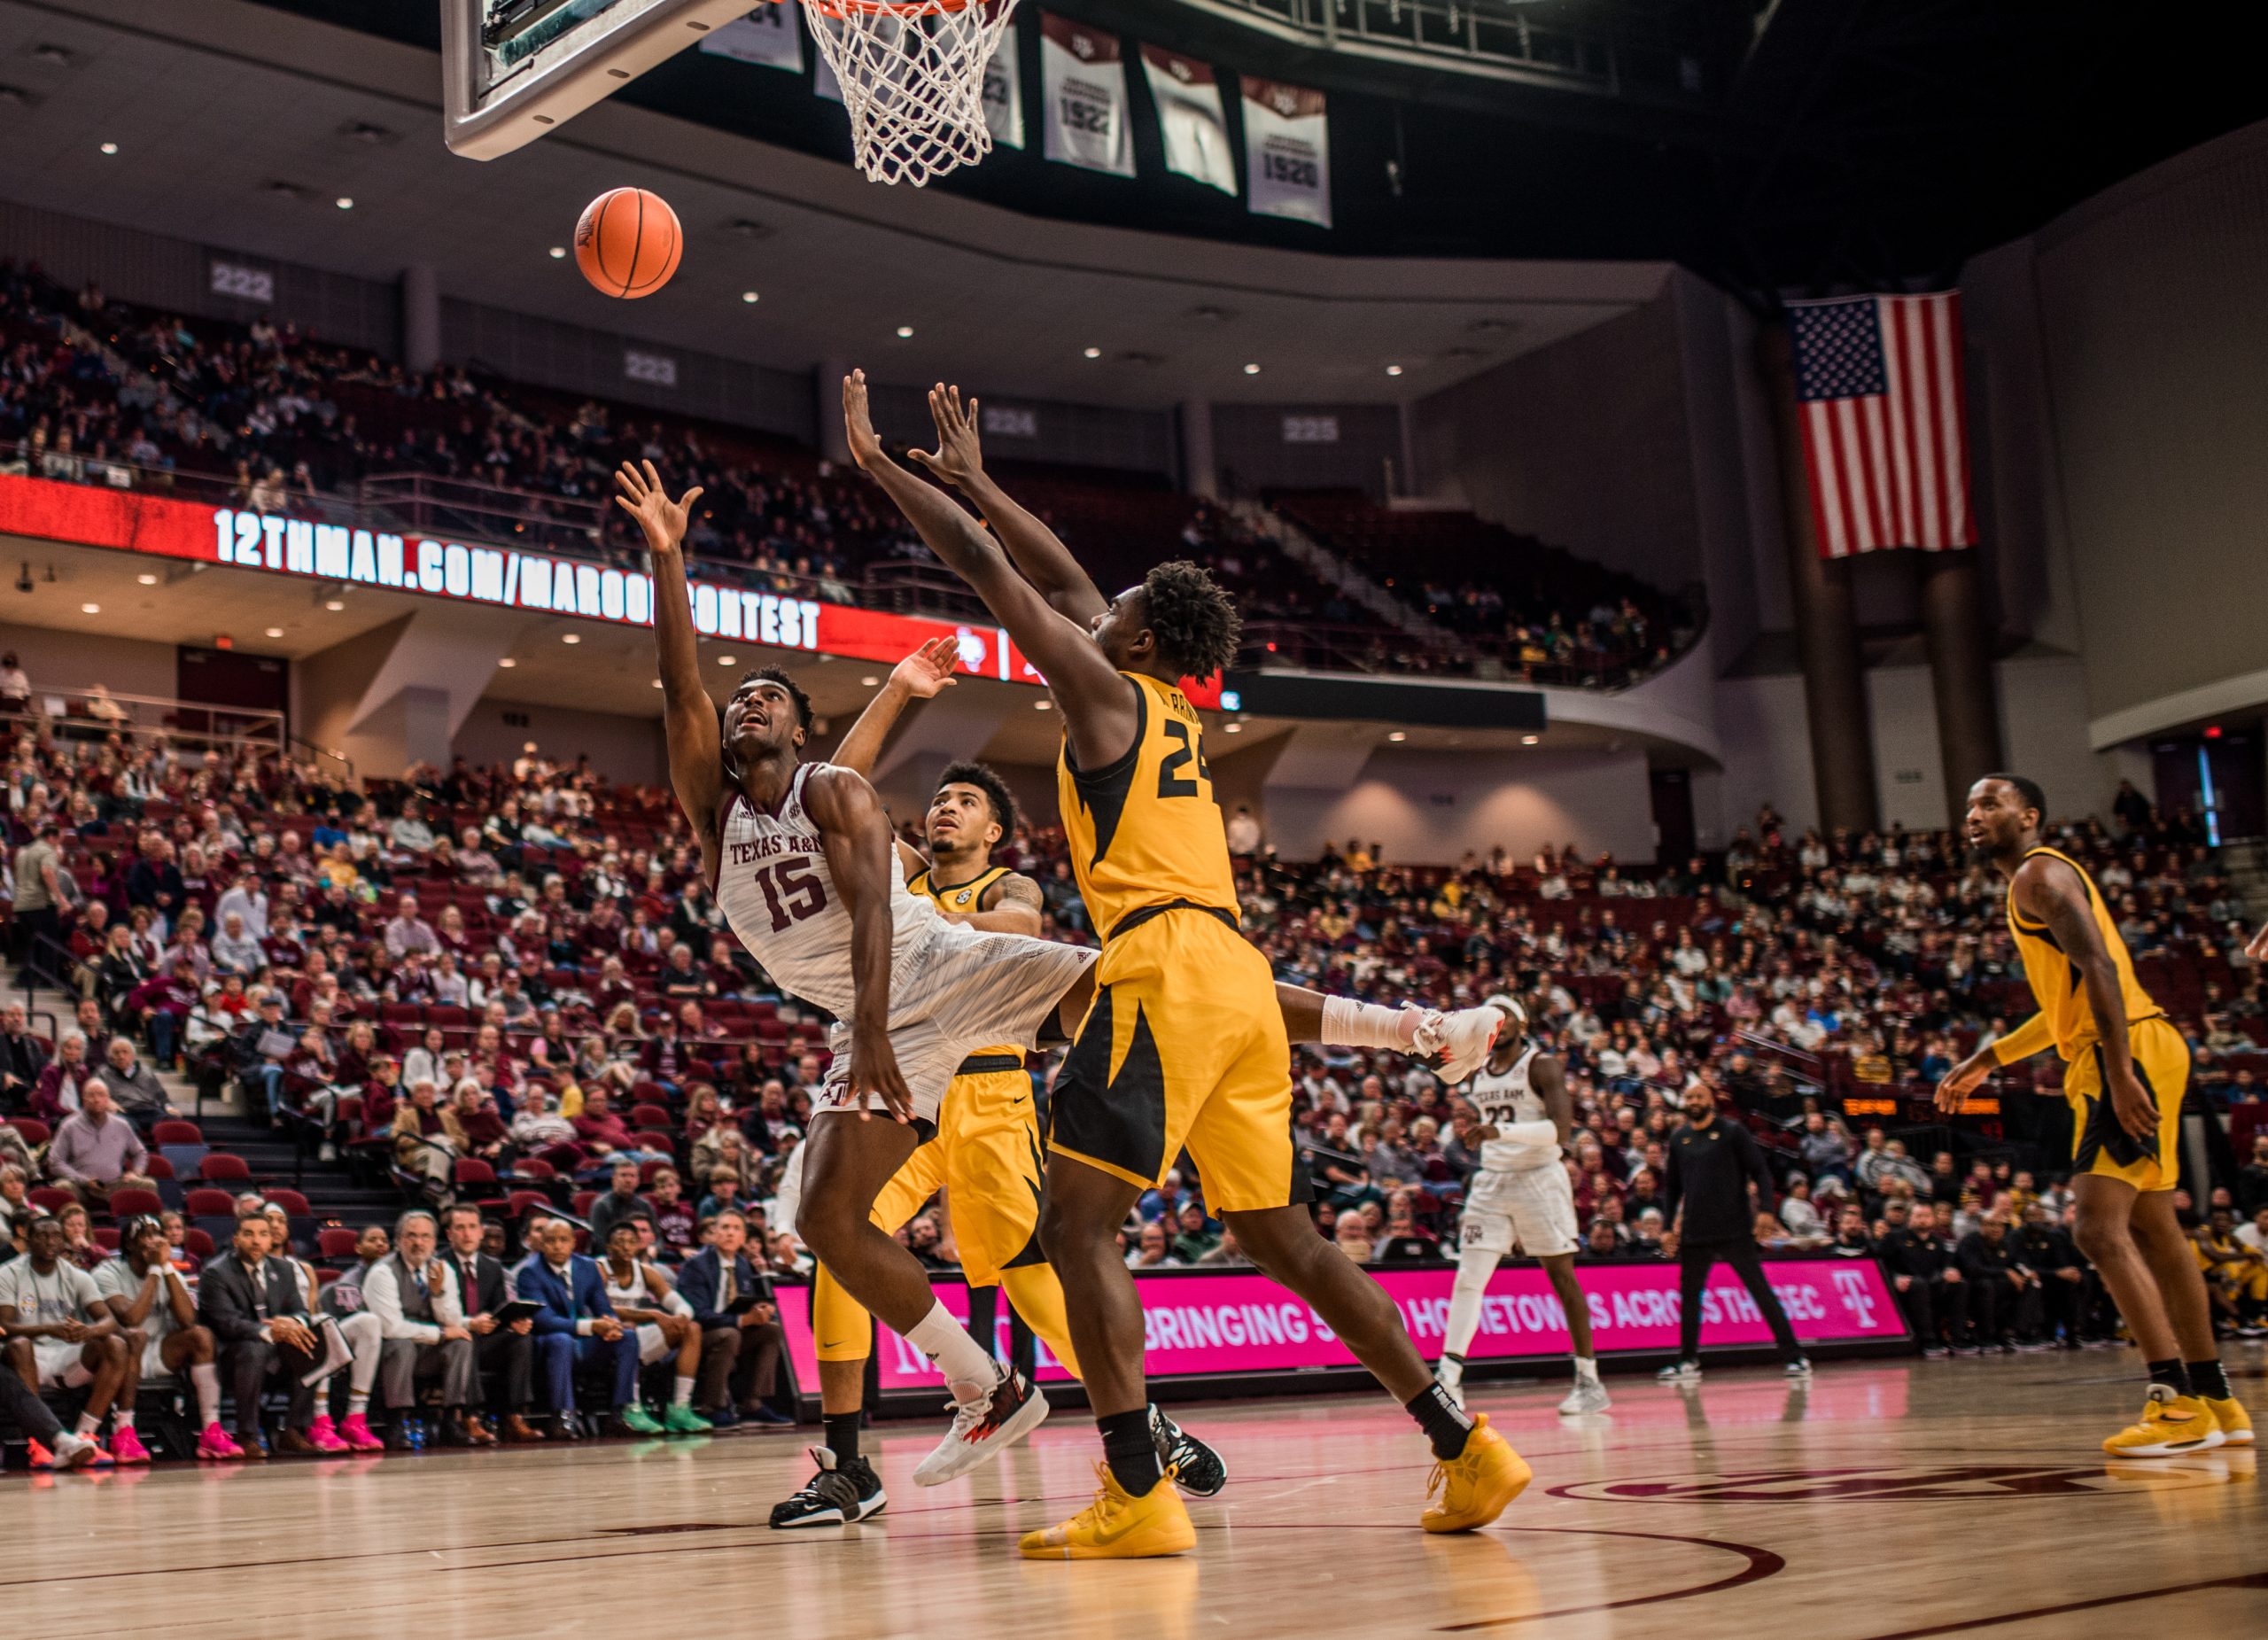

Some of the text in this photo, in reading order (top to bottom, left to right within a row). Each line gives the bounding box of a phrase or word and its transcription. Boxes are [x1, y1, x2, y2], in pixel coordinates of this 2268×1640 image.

[214, 508, 821, 649] 12THMAN.COM/MAROOONTEST
[730, 835, 782, 865] TEXAS
[754, 856, 827, 933] 15
[1406, 1291, 1612, 1338] HOETOWS
[1612, 1289, 1723, 1329] ACROS
